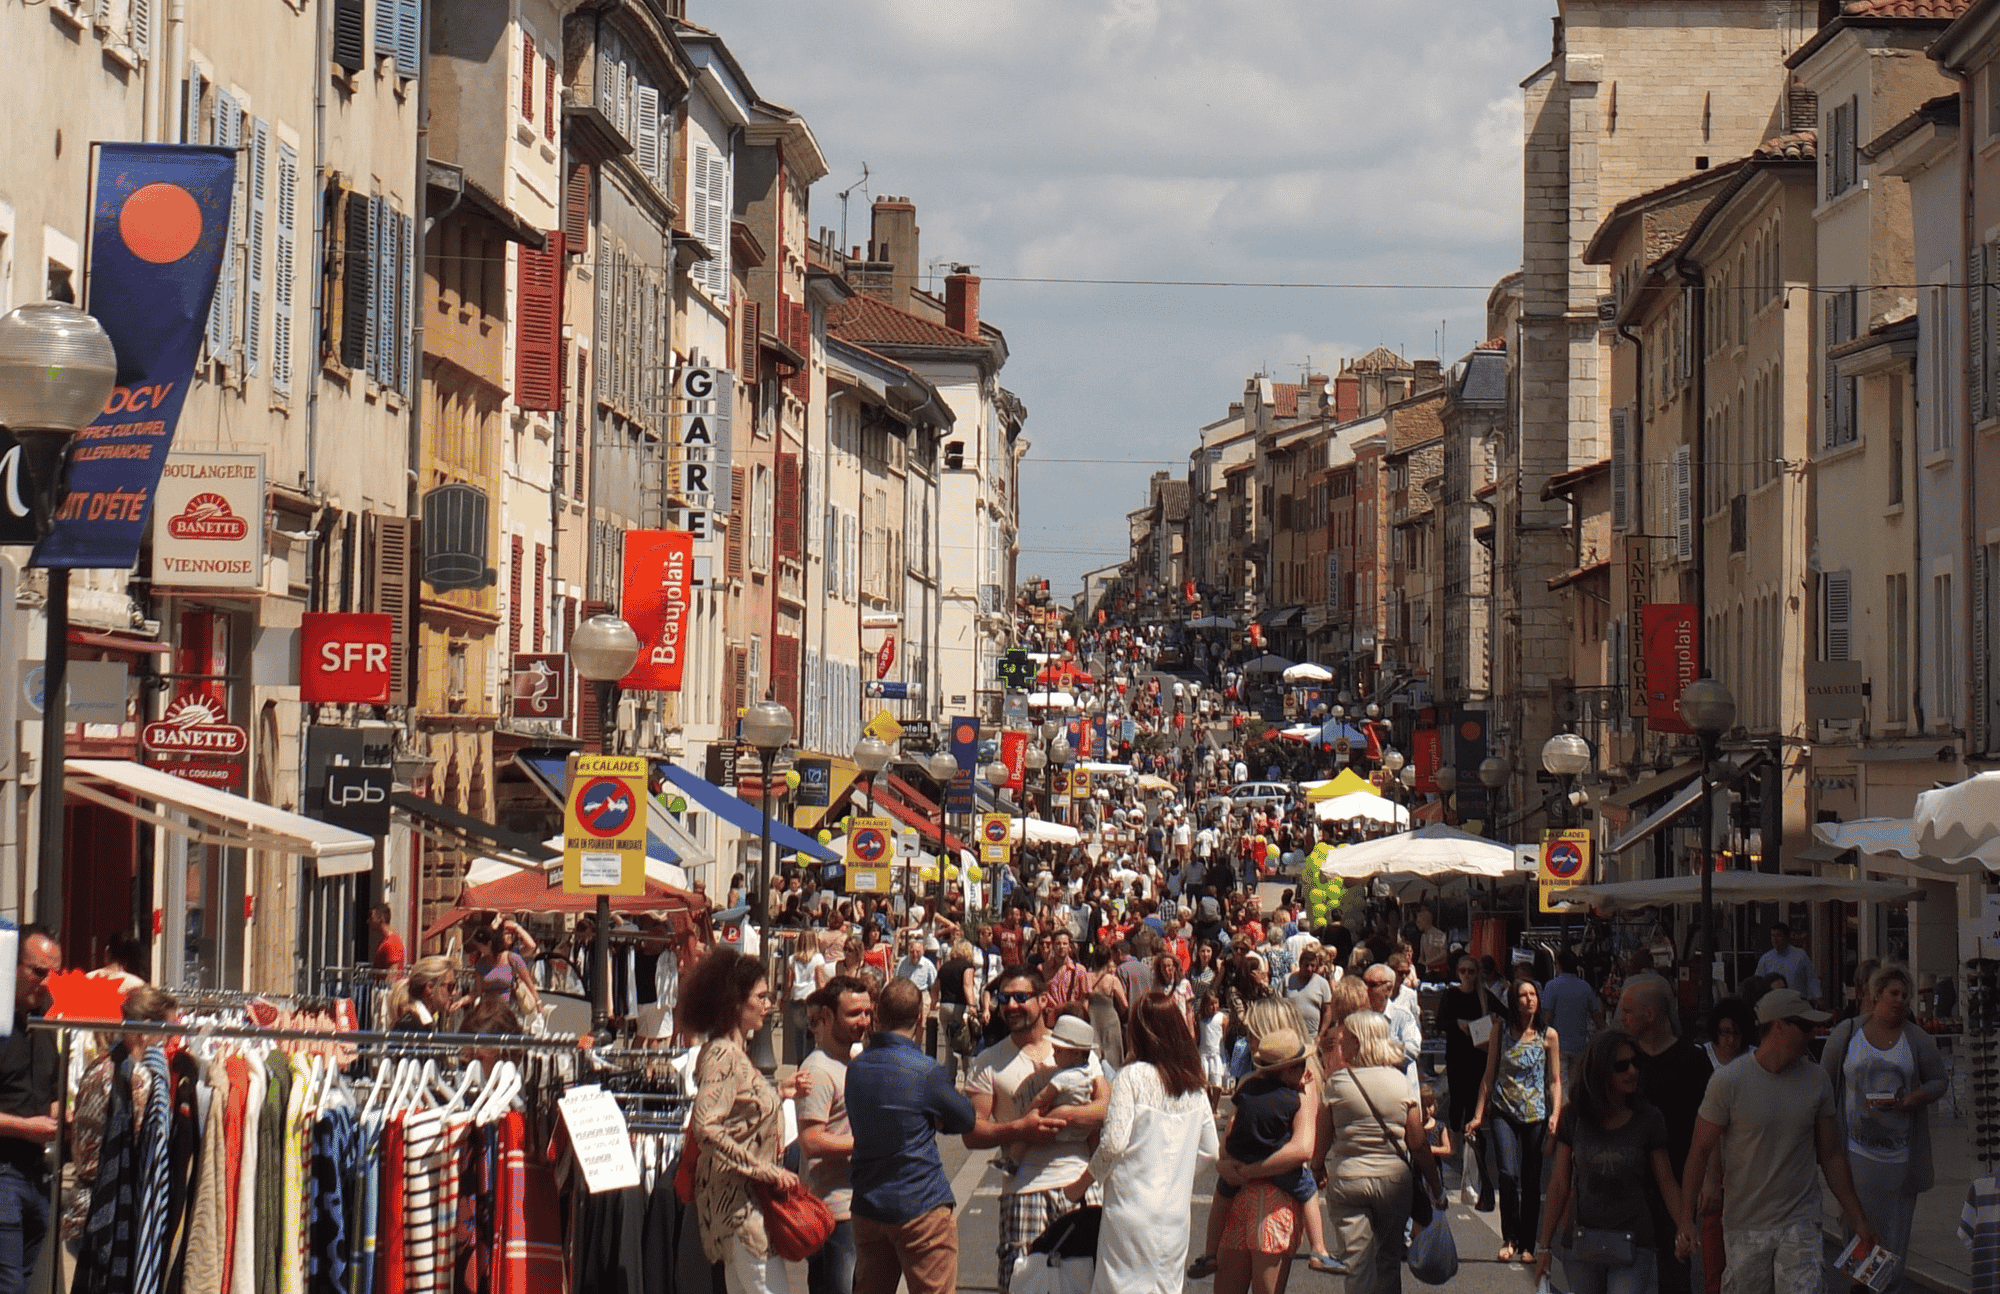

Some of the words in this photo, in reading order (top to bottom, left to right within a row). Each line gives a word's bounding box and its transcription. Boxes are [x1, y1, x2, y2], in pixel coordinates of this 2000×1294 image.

[112, 420, 166, 436] CULTUREL
[163, 464, 256, 479] BOULANGERIE
[685, 369, 712, 586] GAREL
[55, 492, 91, 520] UIT
[88, 486, 147, 521] D'ÉTÉ
[177, 522, 240, 534] BANETTE
[164, 558, 252, 573] VIENNOISE
[650, 551, 686, 665] Beaujolais
[1631, 547, 1648, 707] INTERFLORA
[321, 642, 388, 672] SFR
[152, 729, 237, 747] BANETTE
[189, 769, 229, 779] COQUARD
[574, 761, 590, 771] Les
[593, 761, 639, 771] CALADES
[720, 747, 735, 787] inelli
